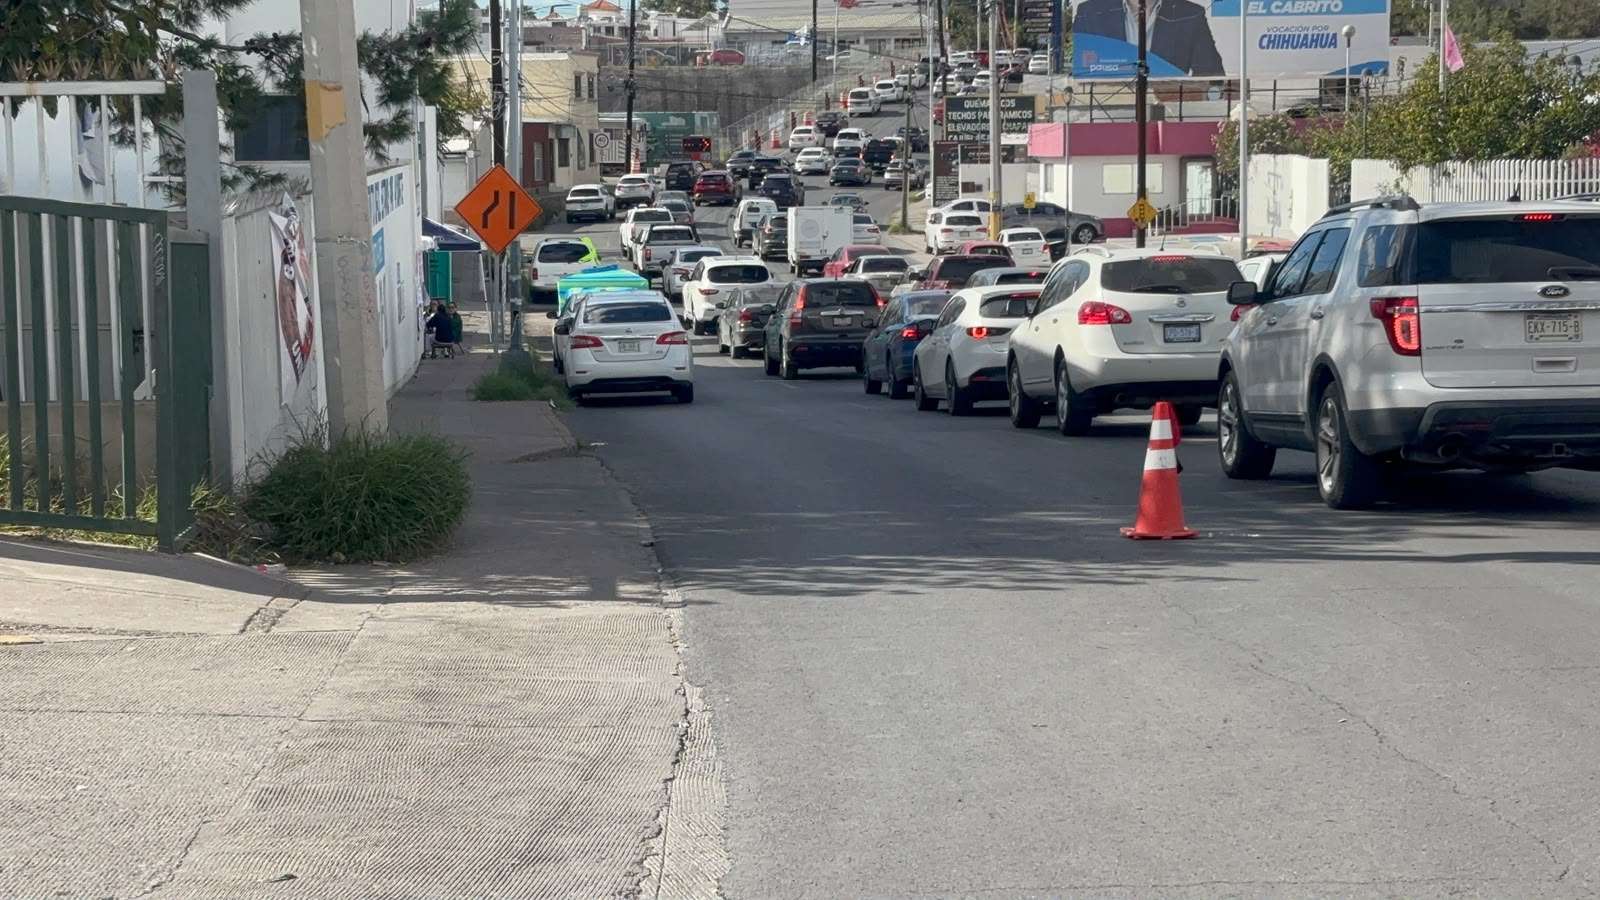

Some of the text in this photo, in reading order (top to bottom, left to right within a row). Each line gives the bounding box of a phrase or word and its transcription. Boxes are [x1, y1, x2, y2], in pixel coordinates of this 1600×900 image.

[1247, 0, 1343, 14] EL CABRITO
[1258, 33, 1338, 50] CHIHUAHUA
[948, 111, 977, 120] TECHOS
[1528, 321, 1580, 333] EKX-715-B
